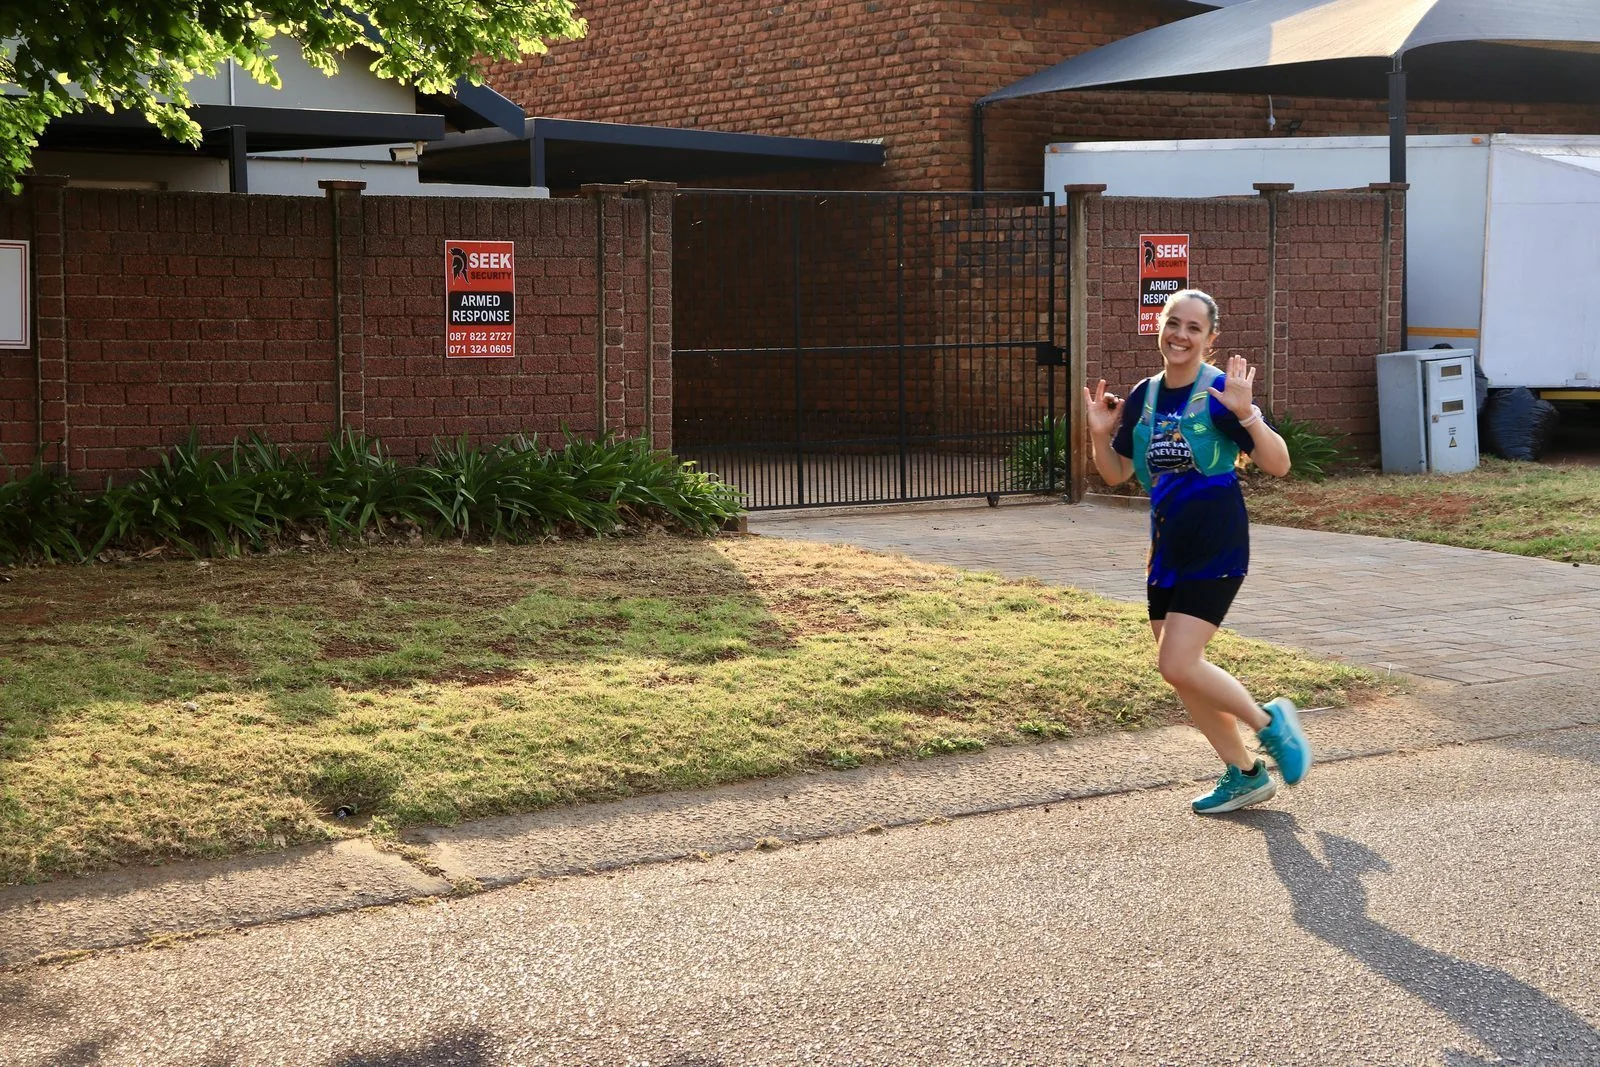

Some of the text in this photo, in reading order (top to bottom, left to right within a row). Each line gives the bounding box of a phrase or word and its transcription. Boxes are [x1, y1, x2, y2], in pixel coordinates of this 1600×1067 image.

[1156, 244, 1187, 258] SEEK
[469, 252, 512, 269] SEEK
[1158, 259, 1187, 268] SECURITY
[470, 271, 512, 280] SECURITY
[1149, 280, 1178, 291] ARMED
[460, 294, 501, 307] ARMED
[1143, 293, 1170, 304] RESPO
[452, 310, 510, 322] RESPONSE
[1141, 312, 1154, 321] 087
[1140, 323, 1154, 332] 071
[449, 332, 512, 341] 087 822 2727
[449, 344, 512, 354] 071 324 0605
[1151, 441, 1171, 449] ERRE
